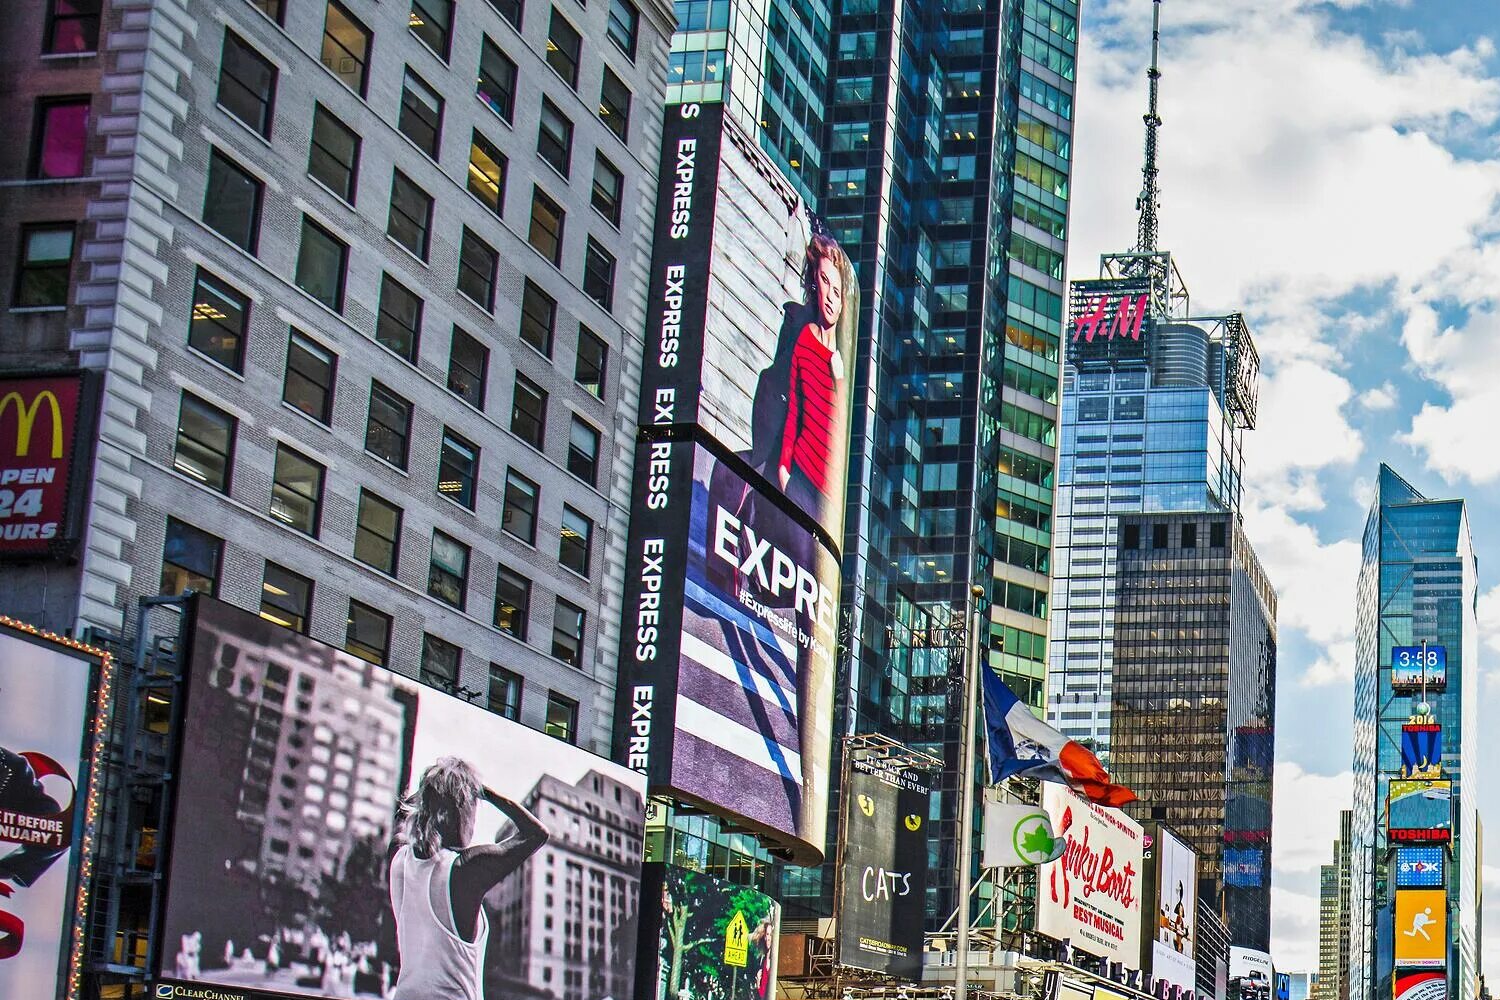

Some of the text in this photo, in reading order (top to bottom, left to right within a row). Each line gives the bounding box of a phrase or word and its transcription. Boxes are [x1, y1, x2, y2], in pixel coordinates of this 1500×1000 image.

[670, 138, 697, 240] EXPRESS
[660, 264, 685, 368] EXPRESS
[1073, 294, 1149, 343] H&M
[0, 467, 56, 485] PEN
[714, 504, 838, 634] EXPRE
[636, 538, 664, 661] EXPRESS
[1399, 651, 1438, 667] 3:58
[1402, 724, 1441, 732] TOSHIBA
[885, 770, 906, 788] THAN
[903, 769, 919, 782] AND
[1094, 803, 1104, 817] AND
[3, 812, 64, 832] IT BEFORE
[56, 833, 62, 846] 1
[1389, 829, 1450, 840] TOSHIBA
[862, 866, 911, 902] CATS
[1097, 846, 1137, 909] Boots
[1073, 903, 1092, 925] BEST
[1094, 914, 1124, 941] MUSICAL
